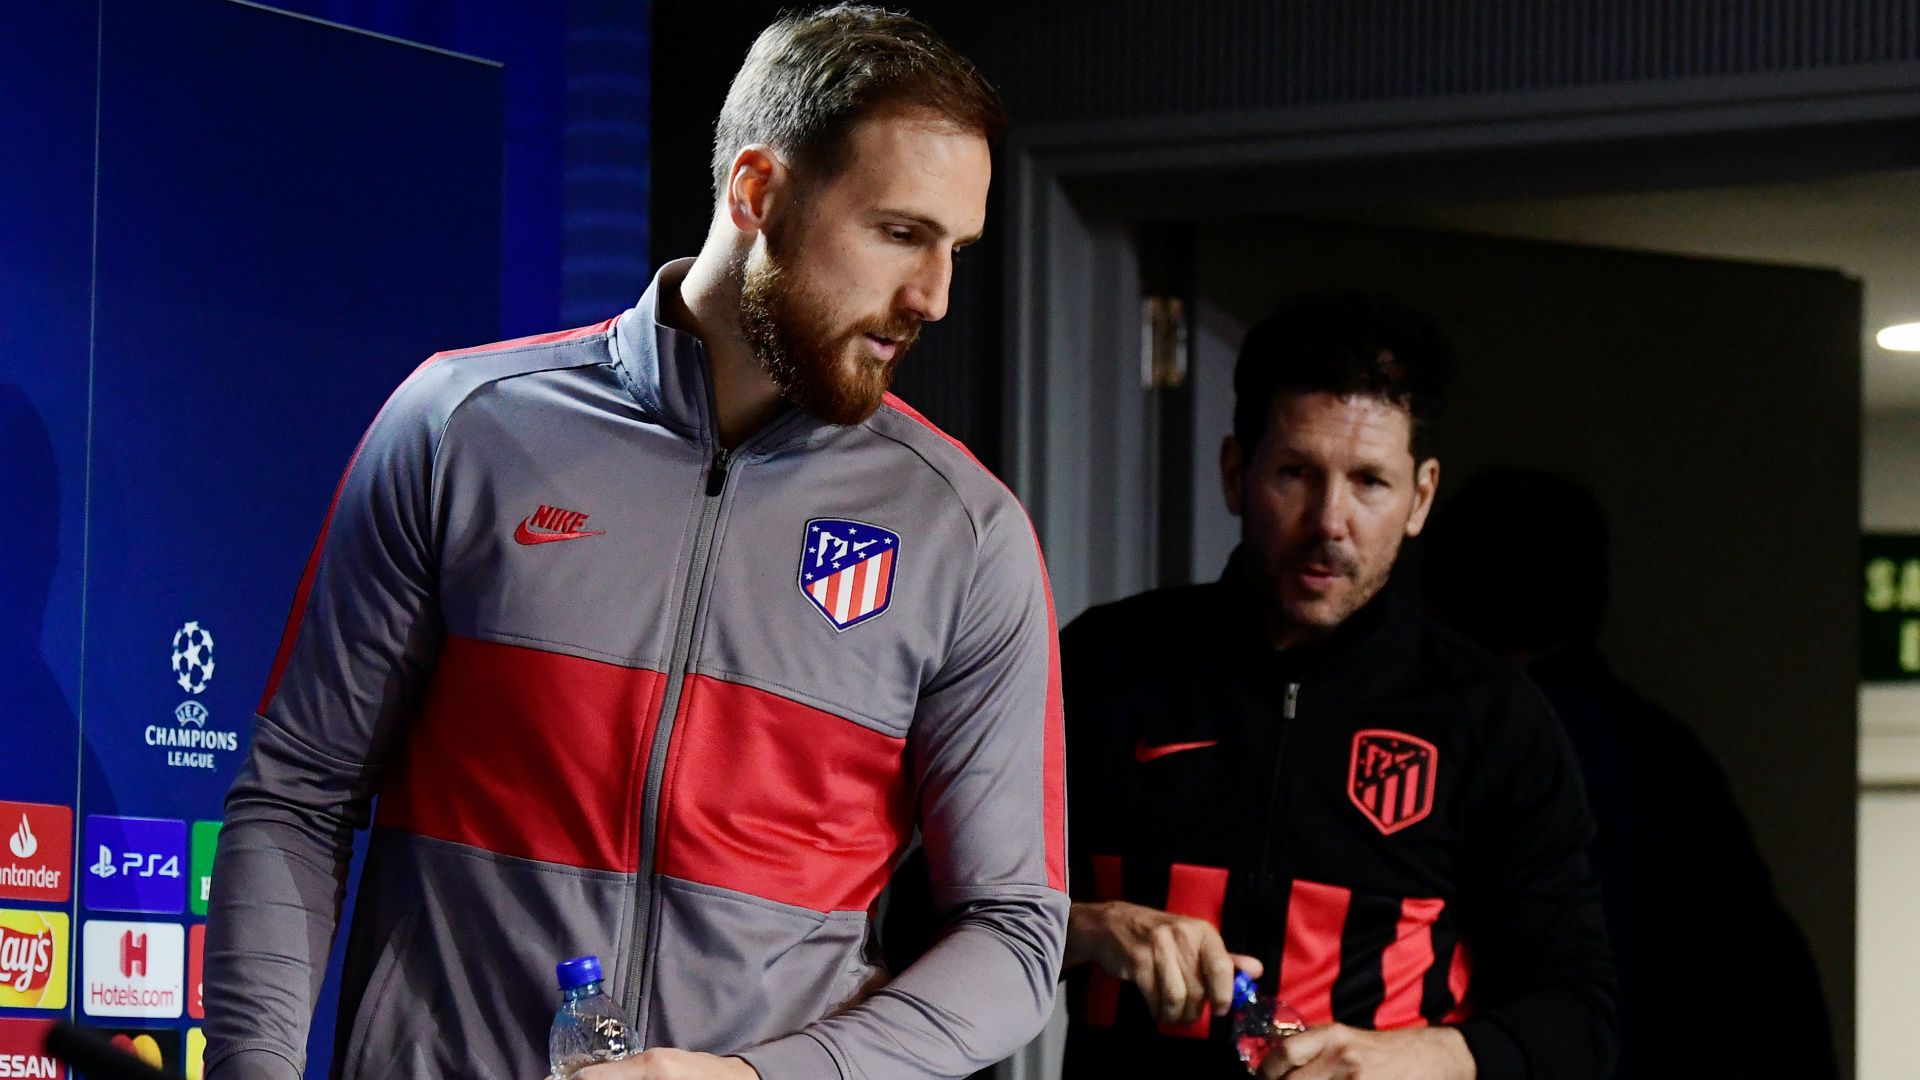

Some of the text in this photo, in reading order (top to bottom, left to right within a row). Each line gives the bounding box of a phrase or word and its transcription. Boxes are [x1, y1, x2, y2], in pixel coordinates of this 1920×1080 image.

[529, 504, 590, 534] NIKE
[176, 703, 207, 724] UEFA
[144, 724, 238, 751] CHAMPIONS
[167, 750, 215, 769] LEAGUE
[0, 863, 61, 889] ntander
[123, 851, 180, 879] PS4
[91, 983, 174, 1007] Hotels.com
